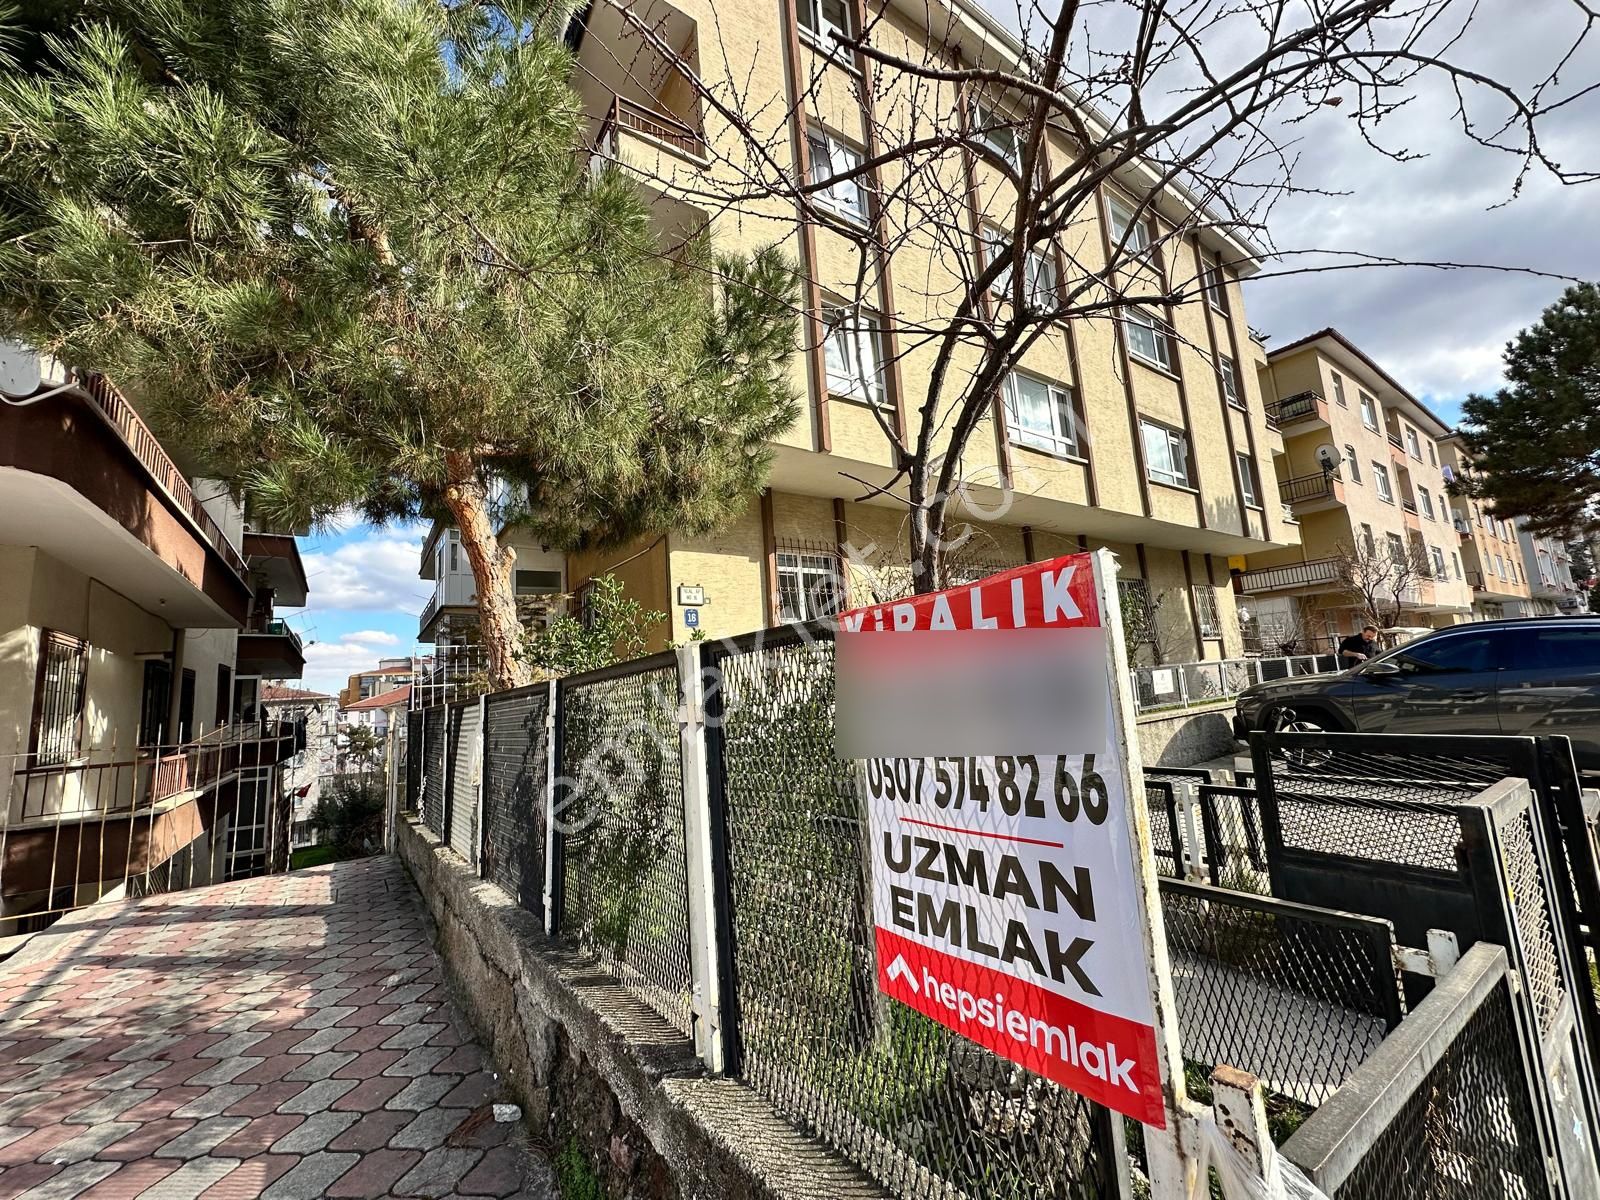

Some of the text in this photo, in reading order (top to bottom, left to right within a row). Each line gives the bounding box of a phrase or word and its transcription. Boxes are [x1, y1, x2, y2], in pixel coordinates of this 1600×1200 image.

[687, 612, 697, 622] 16
[995, 755, 1046, 819] 82
[1054, 754, 1109, 826] 66
[883, 831, 1097, 922] UZMAN
[890, 885, 1103, 998] EMLAK
[922, 966, 1141, 1095] hepsiemlak
